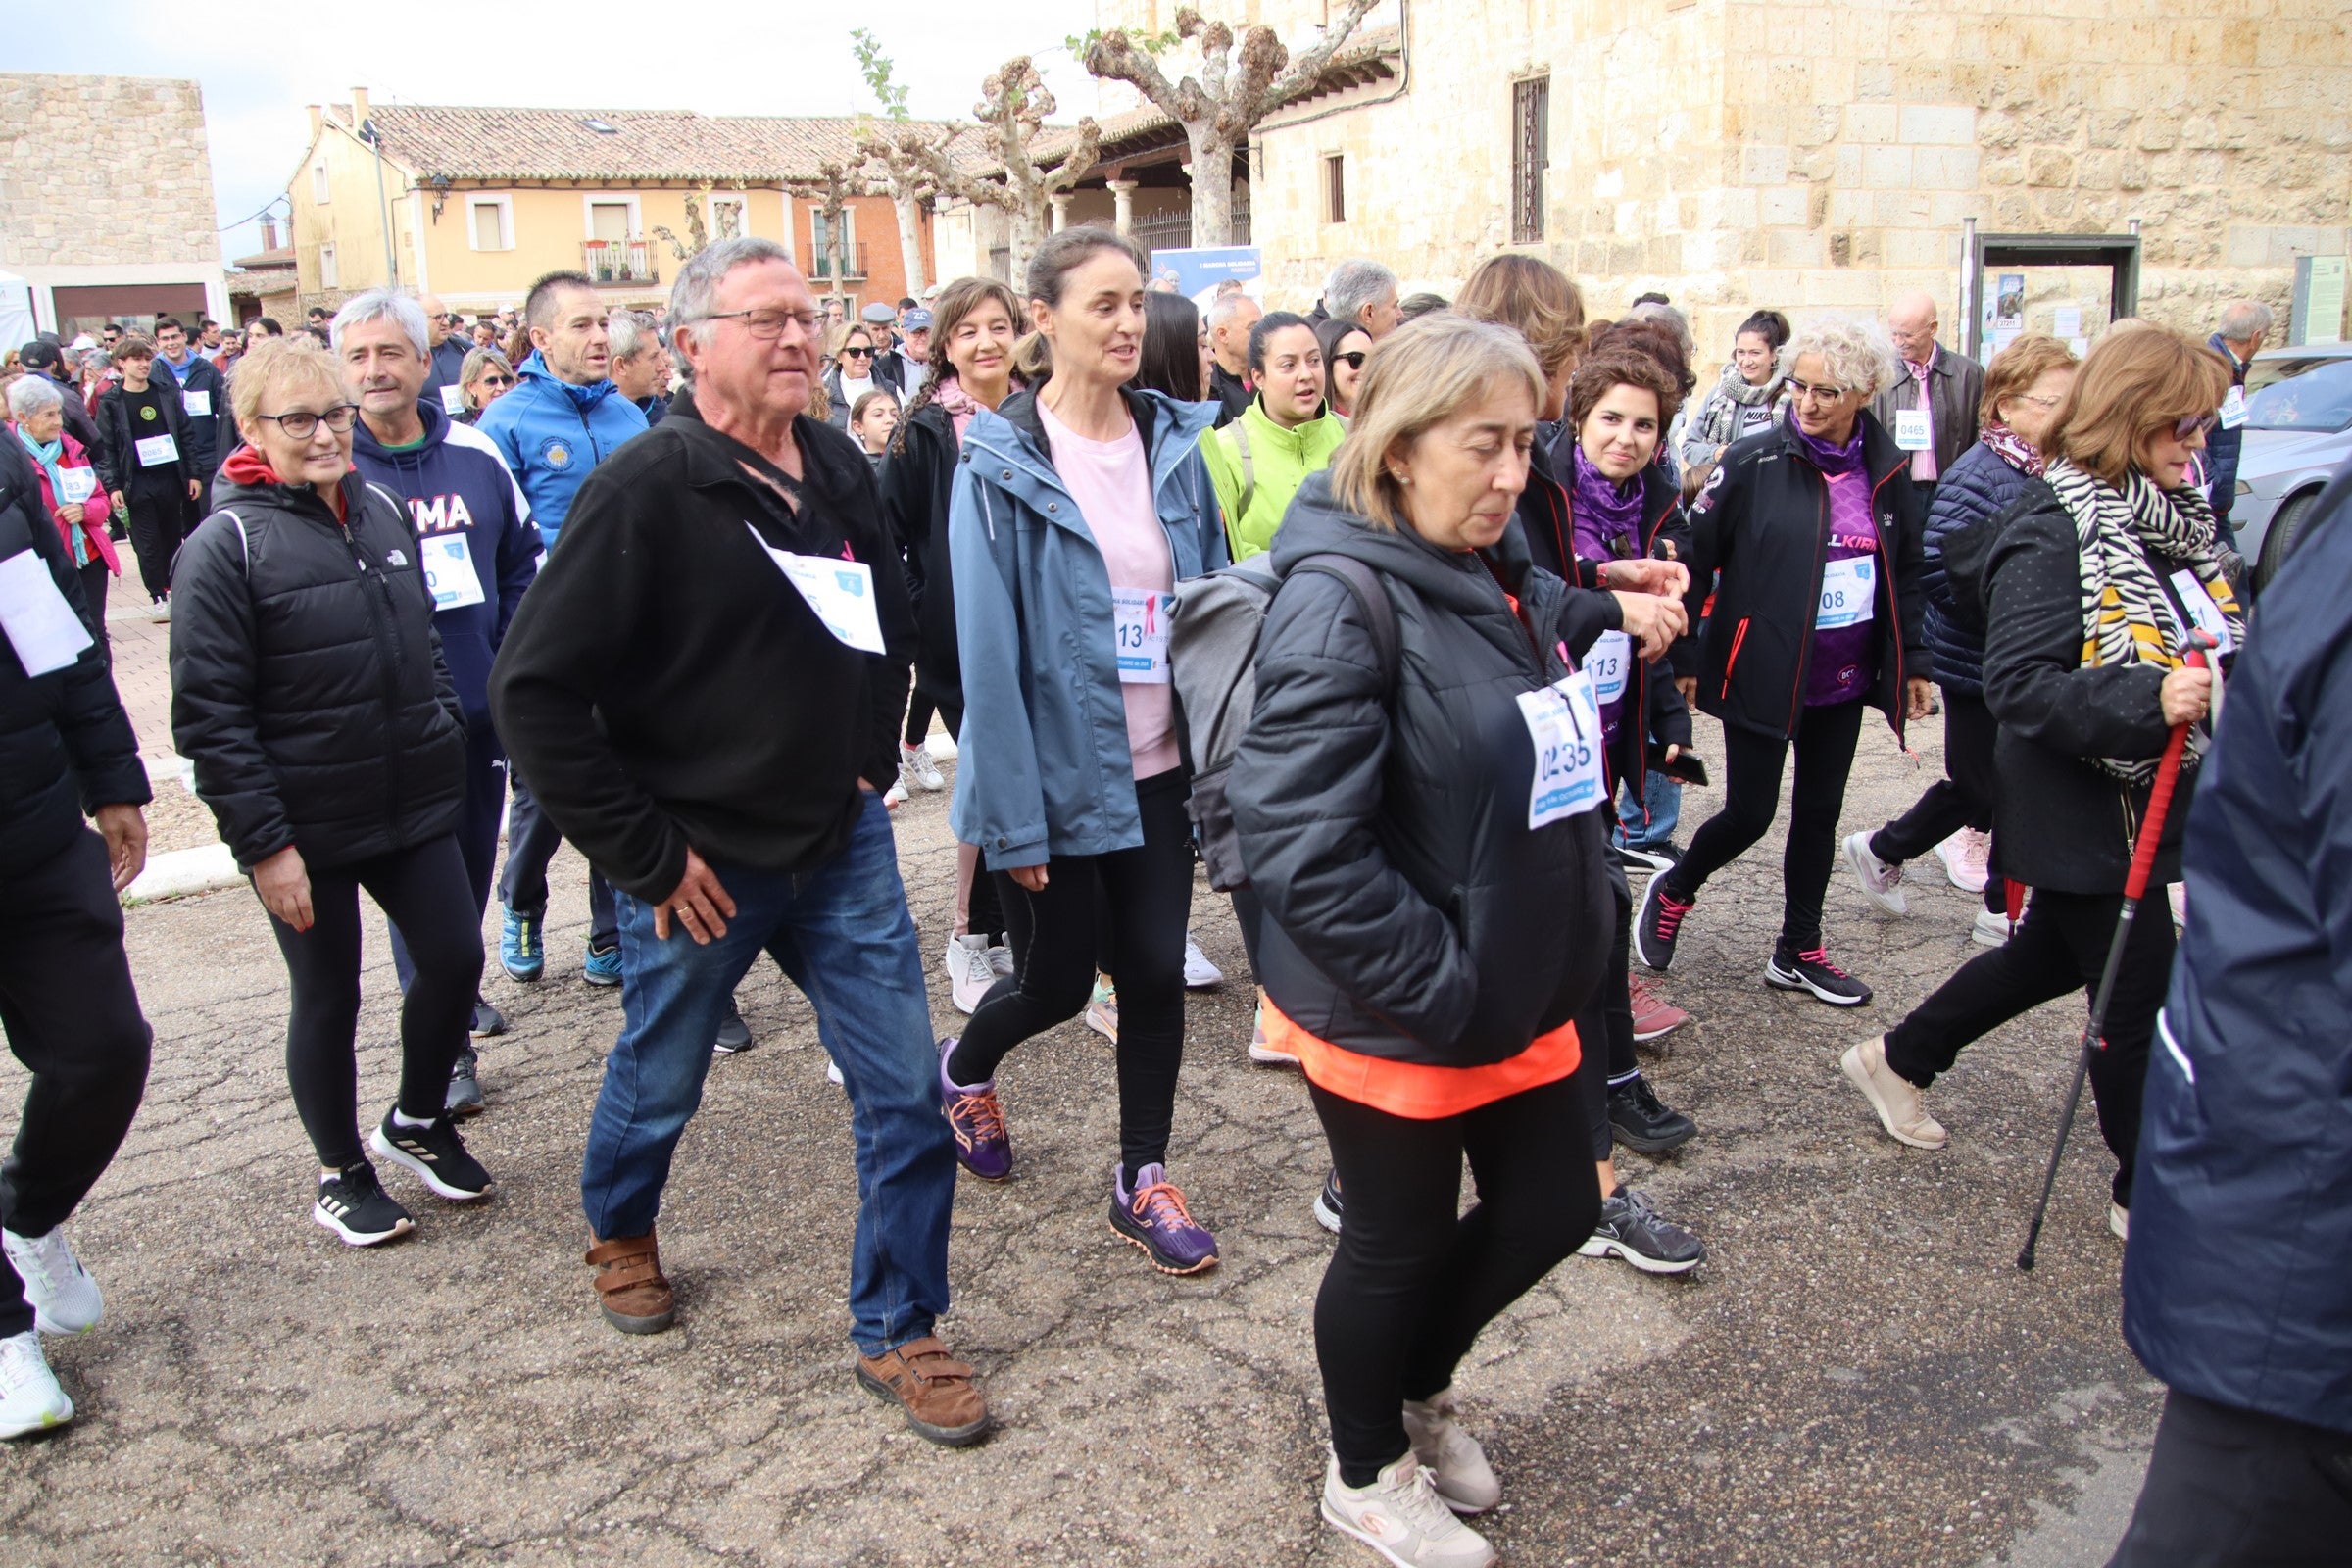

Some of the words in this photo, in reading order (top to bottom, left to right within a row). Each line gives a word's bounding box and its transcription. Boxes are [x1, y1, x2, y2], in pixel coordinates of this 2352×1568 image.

[1900, 424, 1925, 435] 0465
[1822, 590, 1845, 610] 08
[1118, 622, 1143, 648] 13
